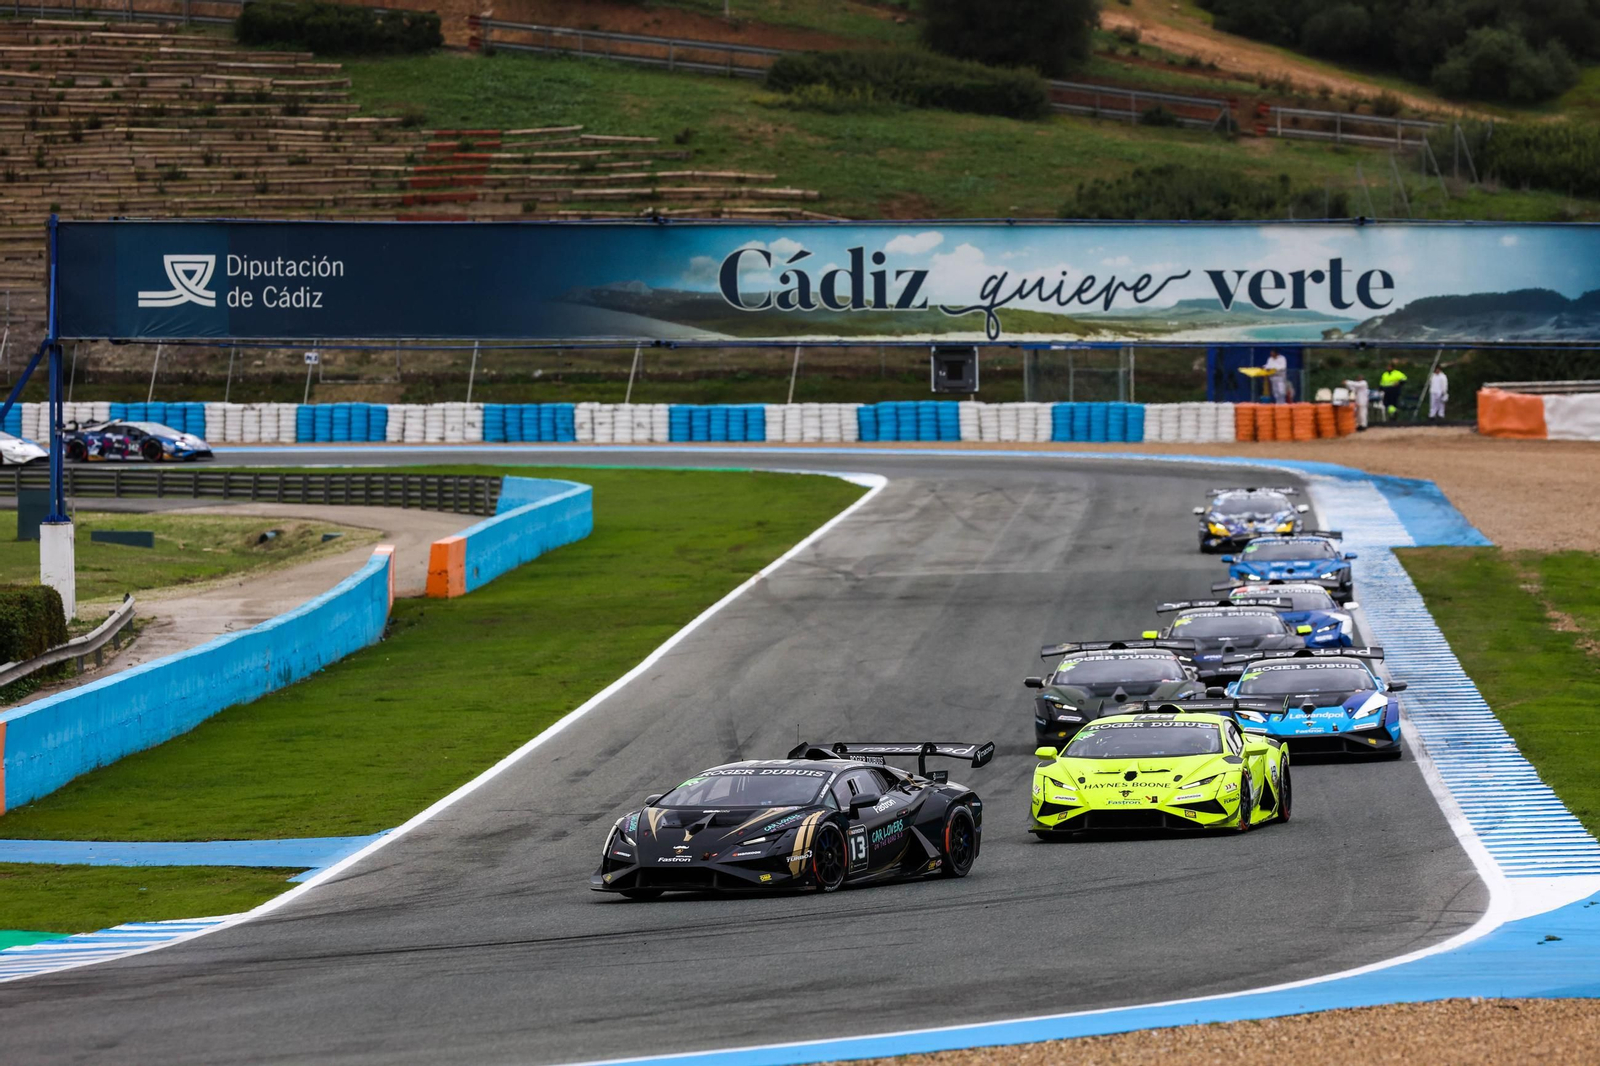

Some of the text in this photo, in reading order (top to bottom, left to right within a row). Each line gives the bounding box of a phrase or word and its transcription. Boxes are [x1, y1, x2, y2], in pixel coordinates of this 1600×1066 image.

[227, 254, 344, 280] Diputación
[227, 286, 323, 308] de Cádiz
[719, 246, 1395, 340] Cádiz quiere verte
[1276, 646, 1371, 657] radstad
[1063, 655, 1115, 664] ROGER
[1252, 664, 1301, 673] ROGER
[1289, 711, 1344, 720] Lewandpol
[1088, 722, 1144, 731] ROGER
[700, 769, 826, 777] ROGER DUBUIS
[872, 797, 897, 814] Fastron
[872, 819, 904, 843] CAR LOVERS
[851, 836, 866, 861] 13
